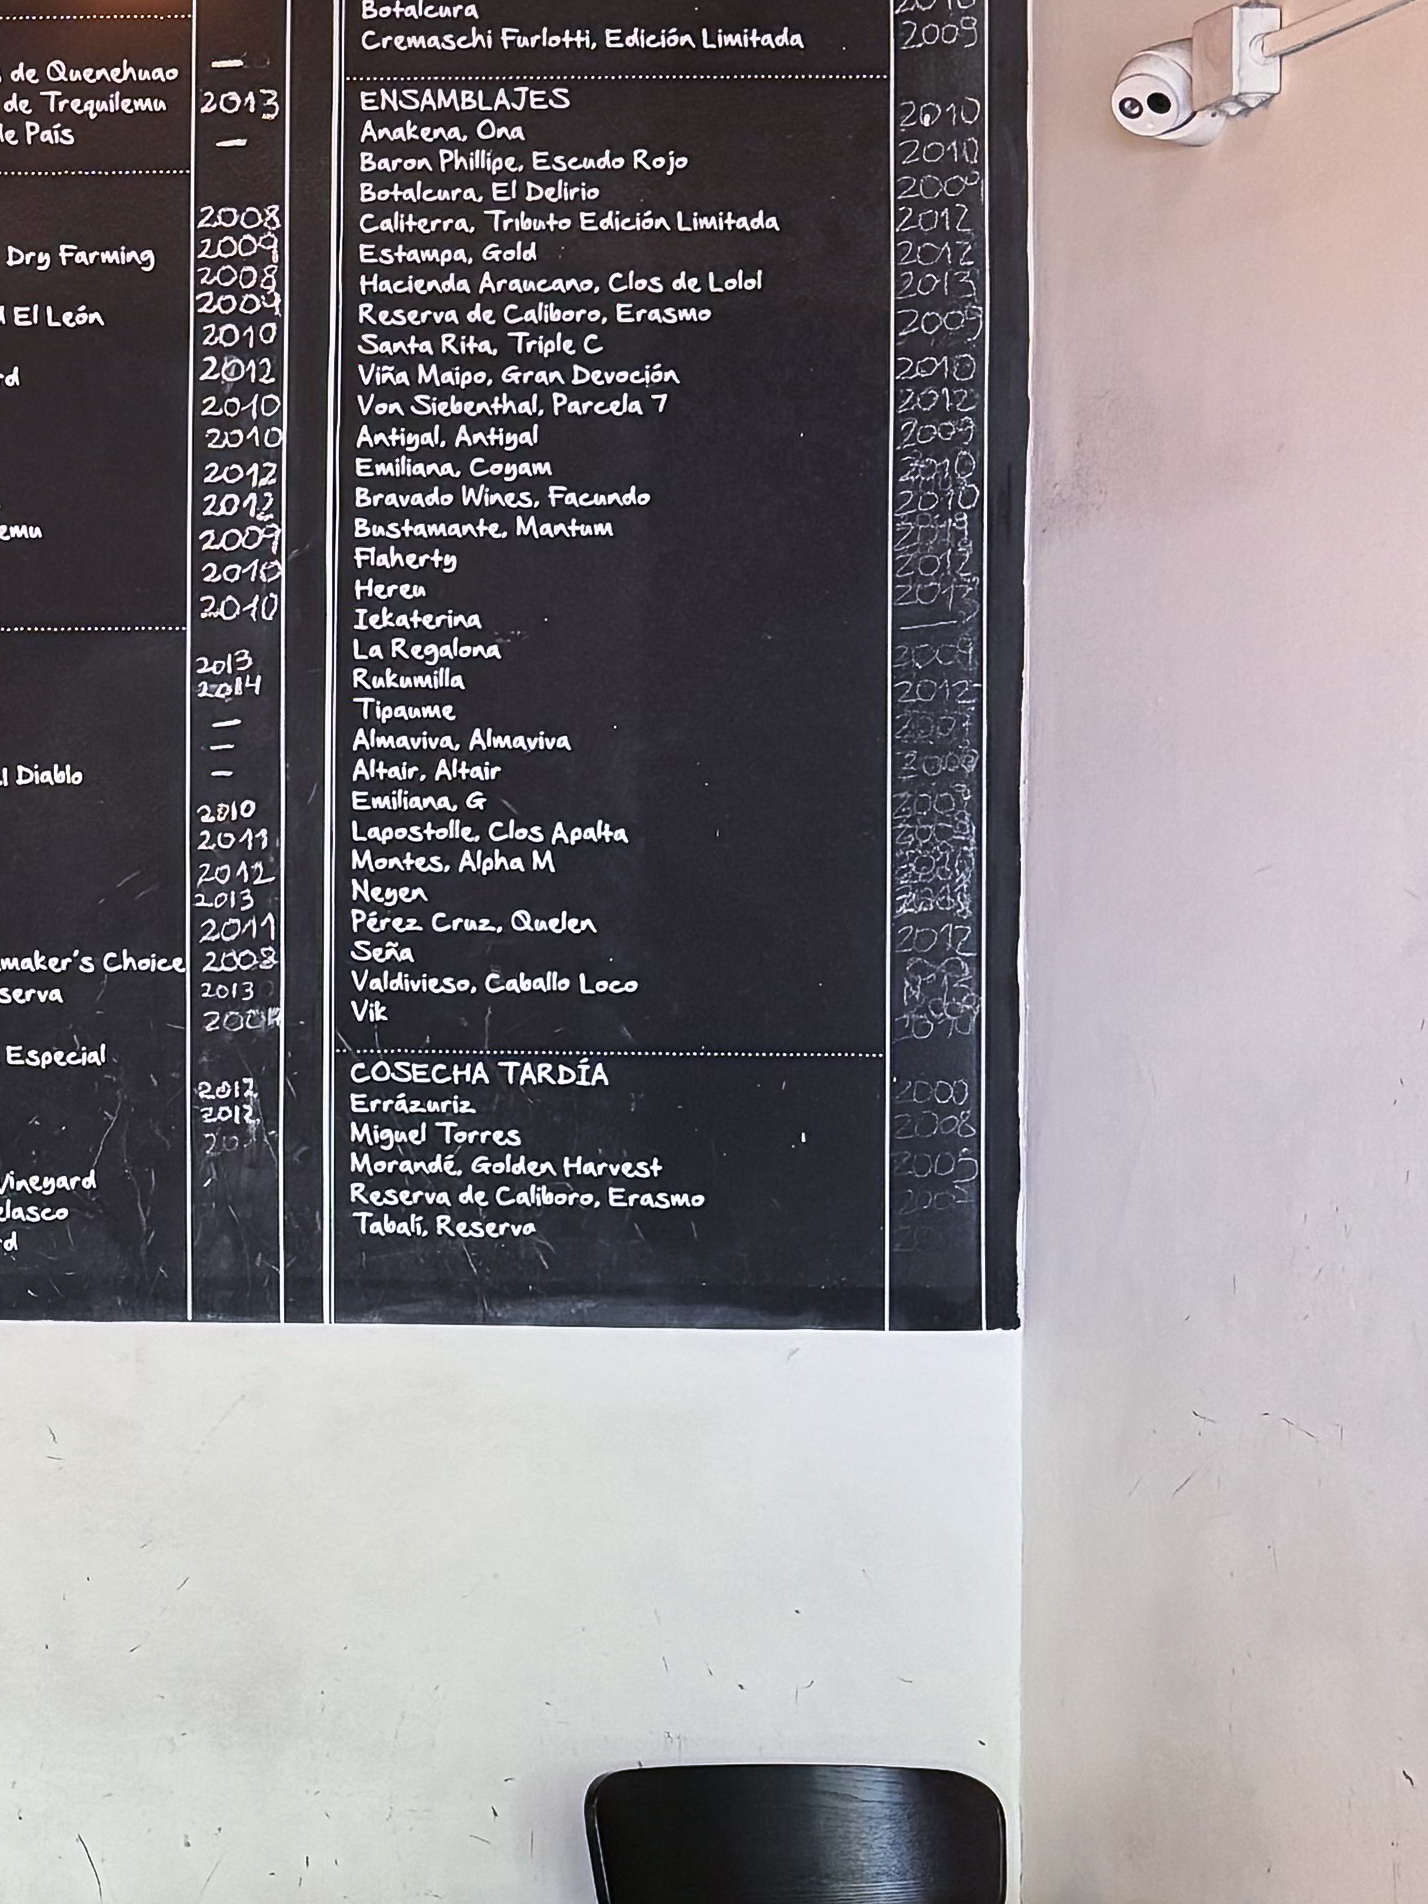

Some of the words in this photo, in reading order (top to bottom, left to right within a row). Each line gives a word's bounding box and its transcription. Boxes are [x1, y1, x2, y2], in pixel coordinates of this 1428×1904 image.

[200, 89, 280, 119] 2013
[360, 86, 571, 113] ENSAMBLAJES
[353, 545, 458, 574] Flaherty
[352, 696, 457, 724] Tipaume
[350, 908, 424, 933] Pérez
[431, 911, 503, 934] Cruz,
[510, 909, 598, 934] Quelen
[350, 1060, 490, 1085] COSECHA
[497, 1057, 610, 1087] TARDÍA
[350, 1151, 463, 1177] Morandé,
[470, 1152, 558, 1178] Golden
[562, 1155, 663, 1179] Harvest
